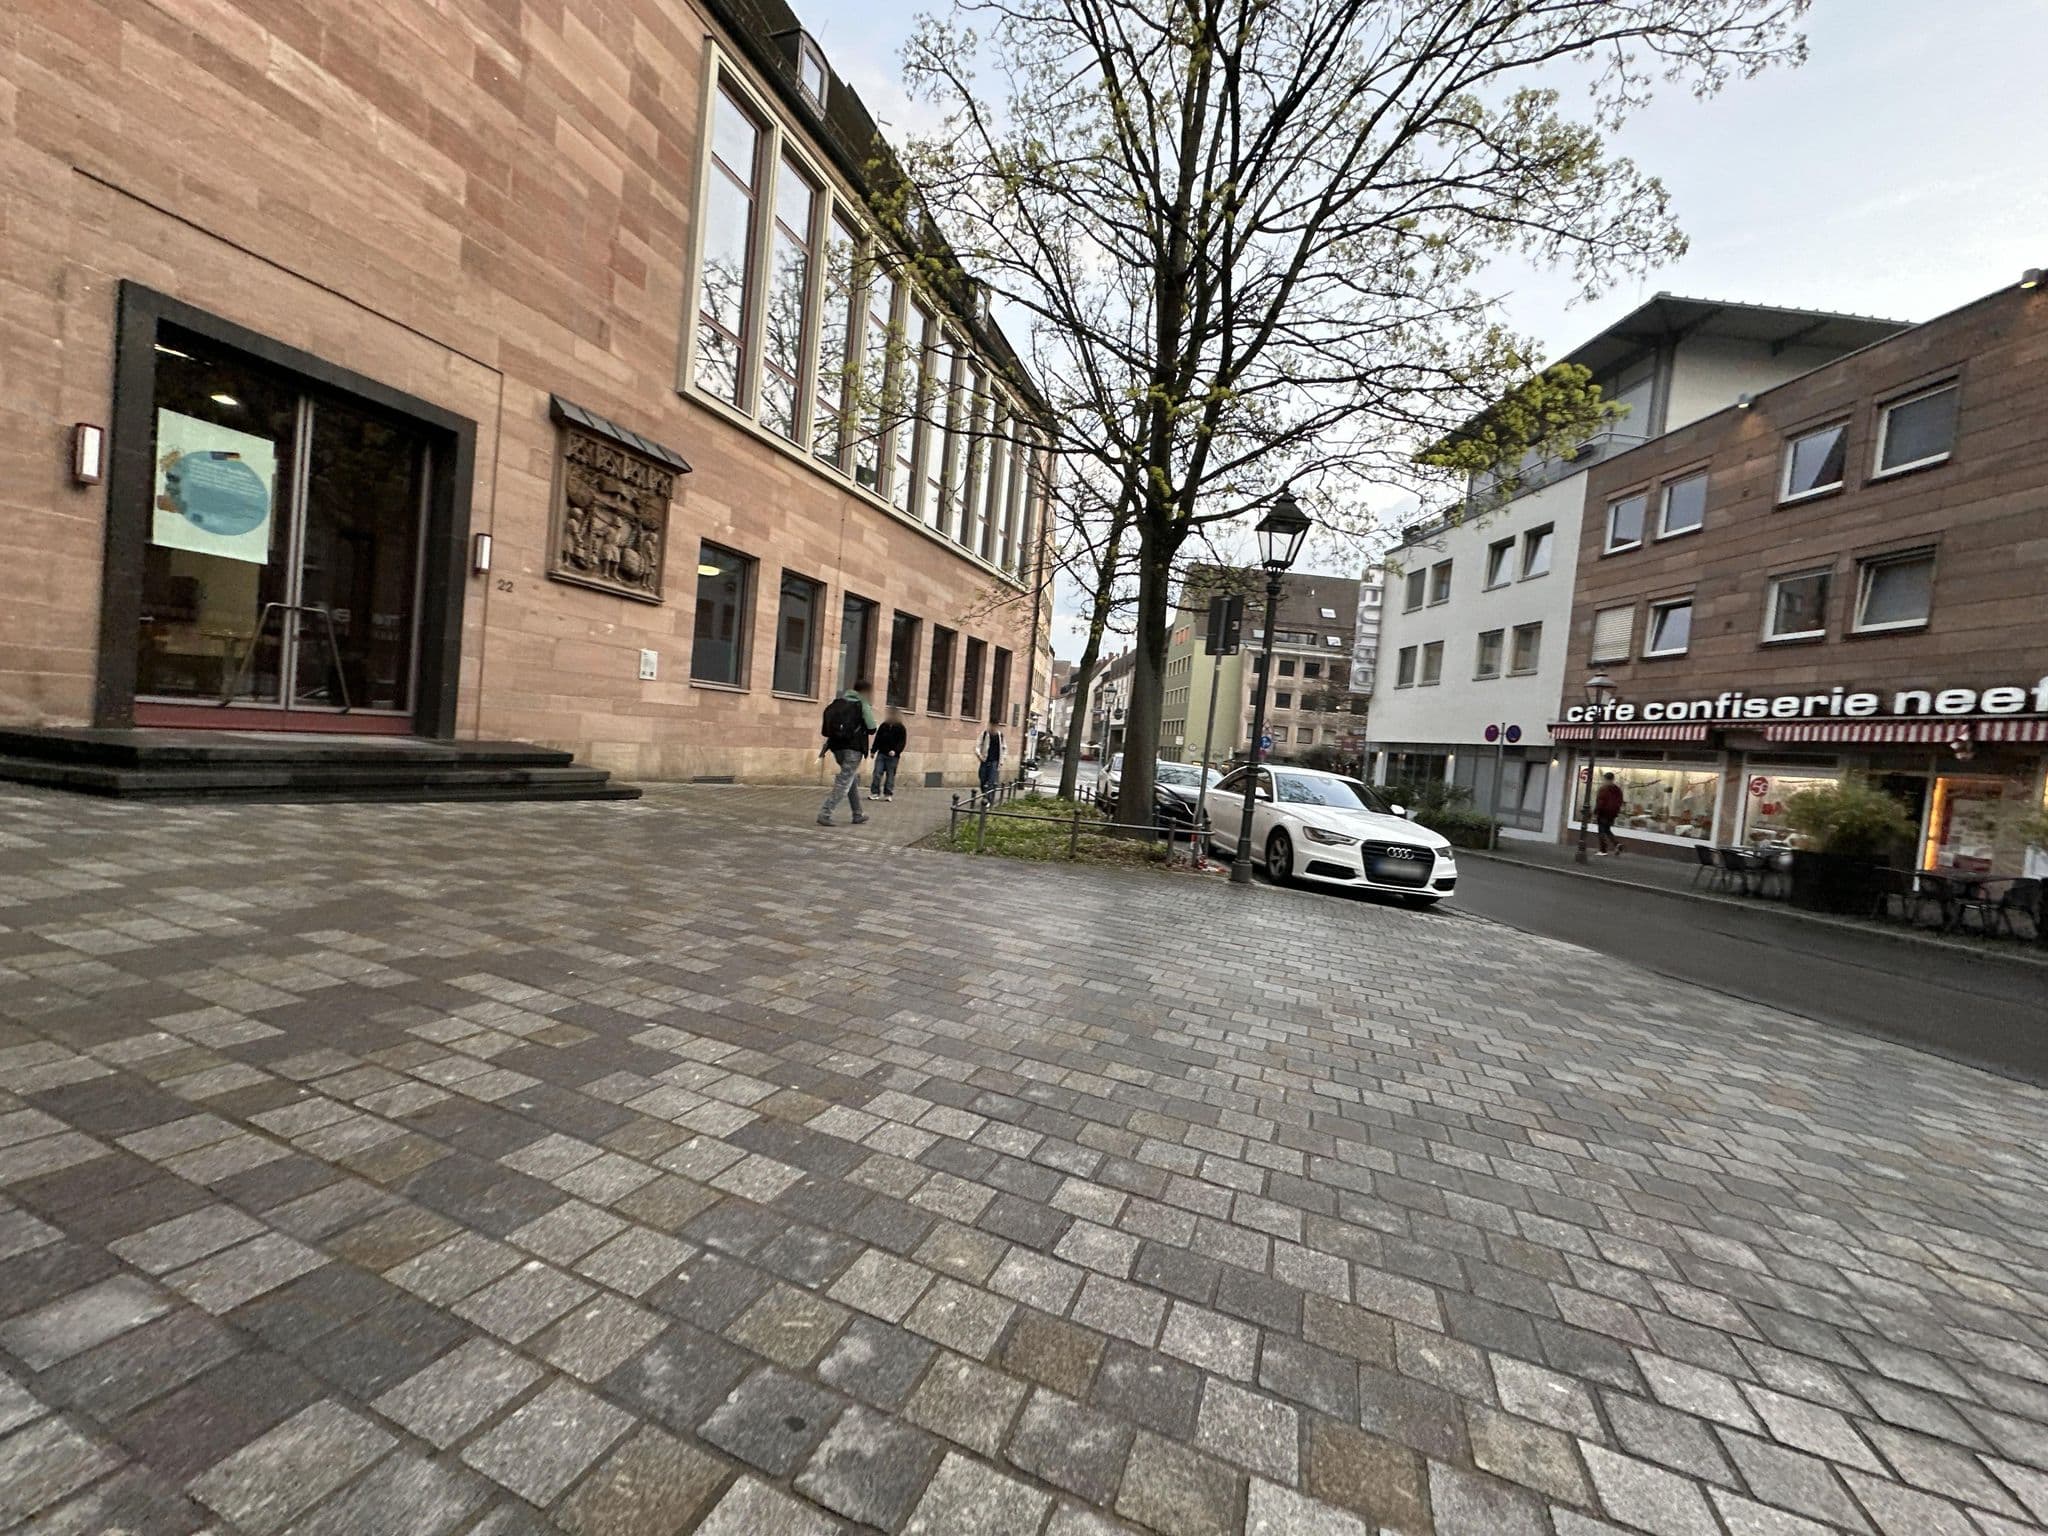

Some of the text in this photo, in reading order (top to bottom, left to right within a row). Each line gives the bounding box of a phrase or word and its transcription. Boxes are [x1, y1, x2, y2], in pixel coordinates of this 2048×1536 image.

[496, 579, 514, 593] 22
[1567, 698, 1635, 722] cafe
[1643, 686, 1878, 721] confiserie
